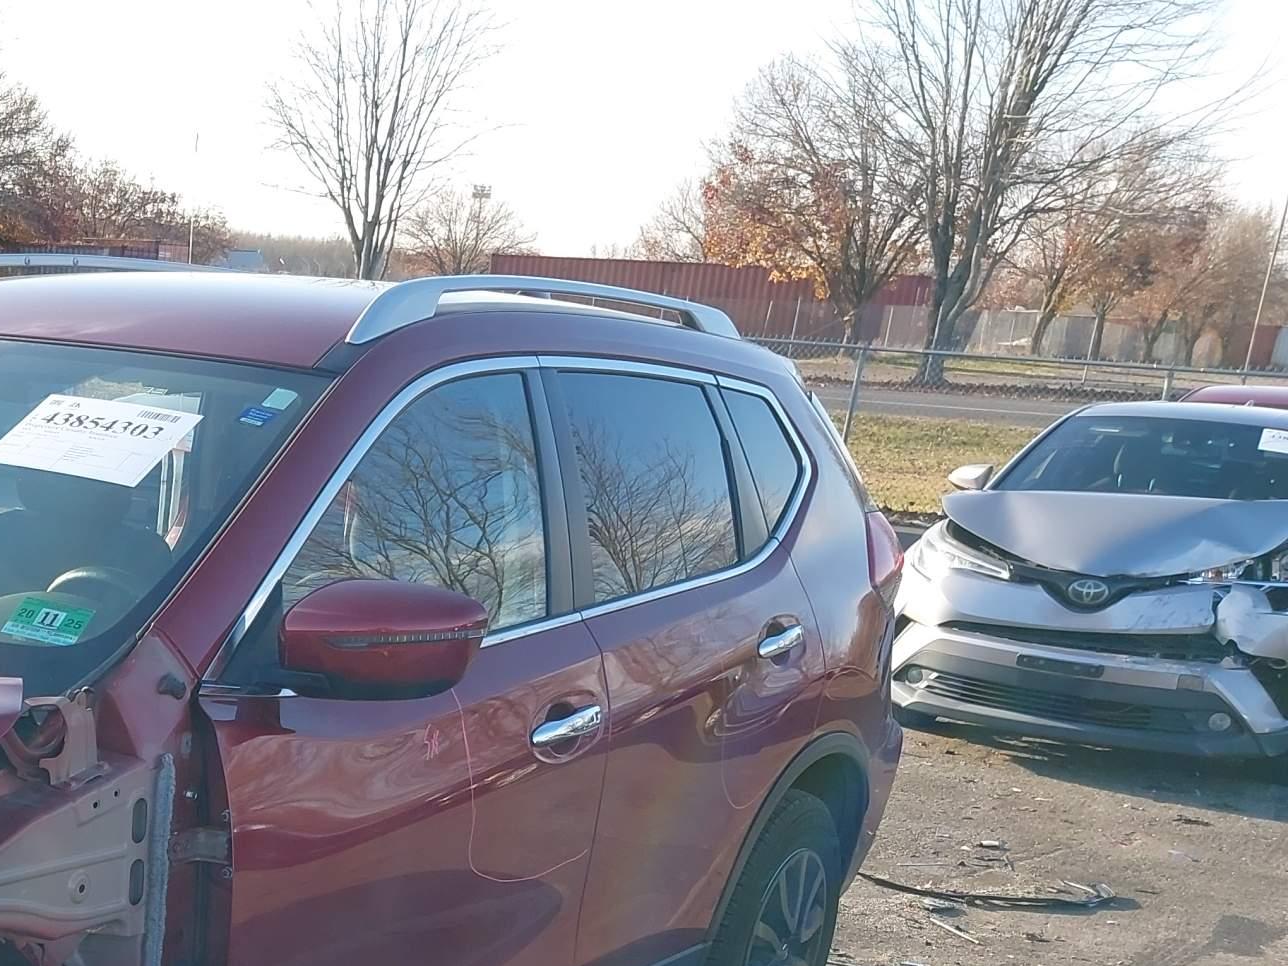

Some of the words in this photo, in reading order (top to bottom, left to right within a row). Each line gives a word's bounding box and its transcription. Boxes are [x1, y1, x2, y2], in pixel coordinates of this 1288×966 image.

[40, 411, 165, 440] 43854303
[18, 607, 35, 619] 20
[38, 611, 60, 628] 11
[64, 618, 84, 630] 25
